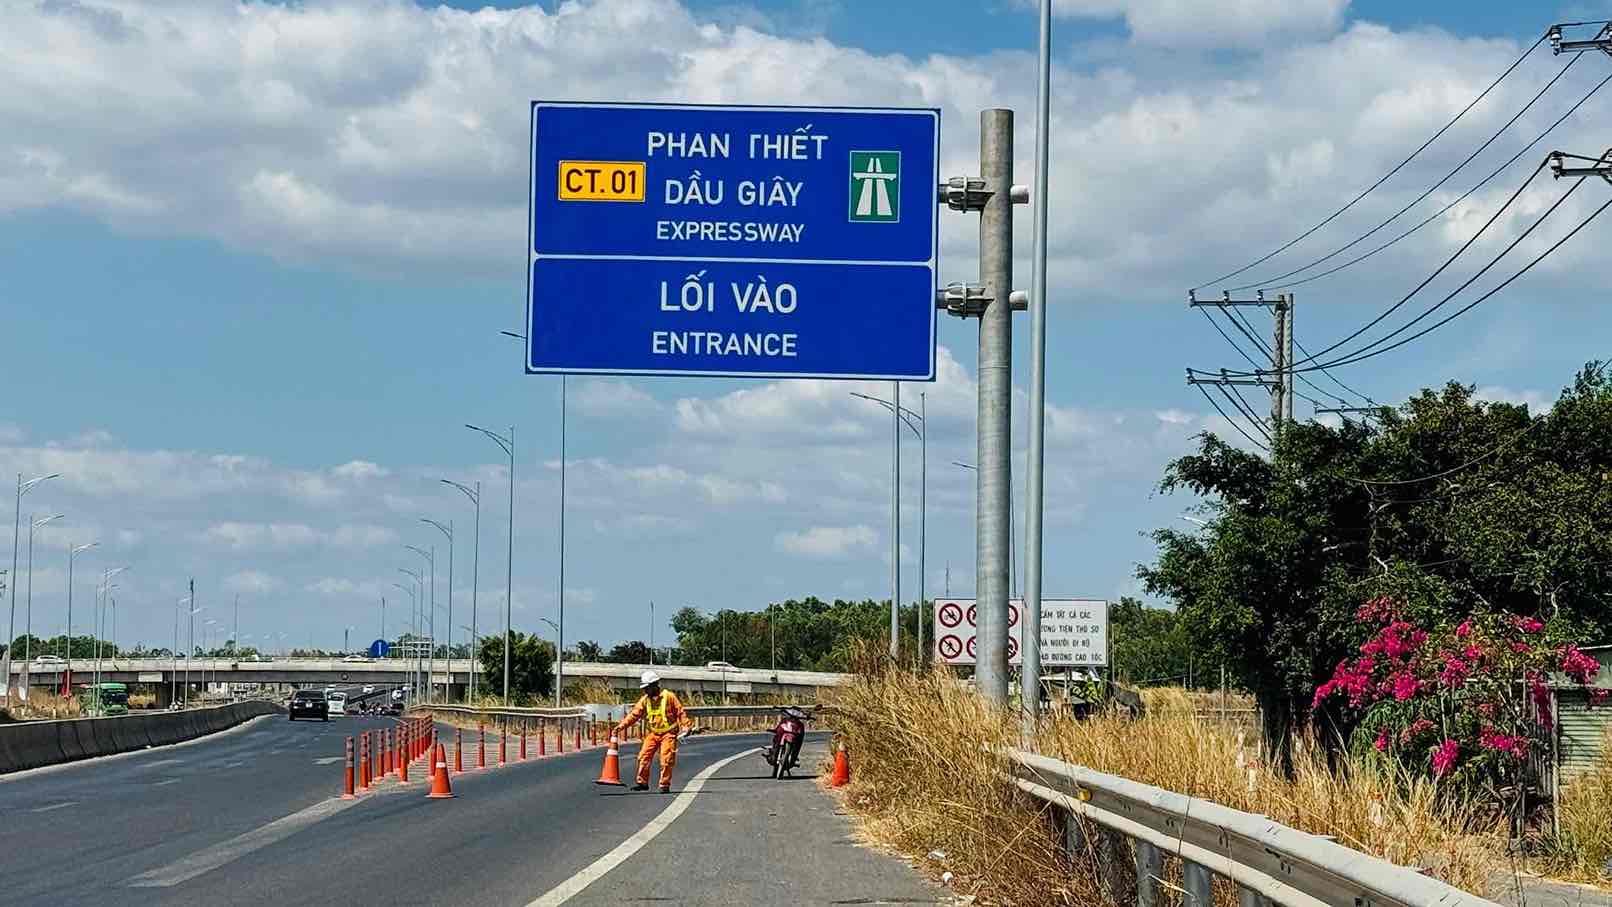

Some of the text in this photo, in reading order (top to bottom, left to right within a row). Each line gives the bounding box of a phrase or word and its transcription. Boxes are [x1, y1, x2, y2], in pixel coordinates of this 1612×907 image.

[648, 124, 828, 160] PHAN THIẾT
[666, 170, 803, 207] DẦU GIÂY
[656, 220, 804, 242] EXPRESSWAY
[661, 270, 797, 314] LỐI VÀO
[652, 331, 798, 356] ENTRANCE
